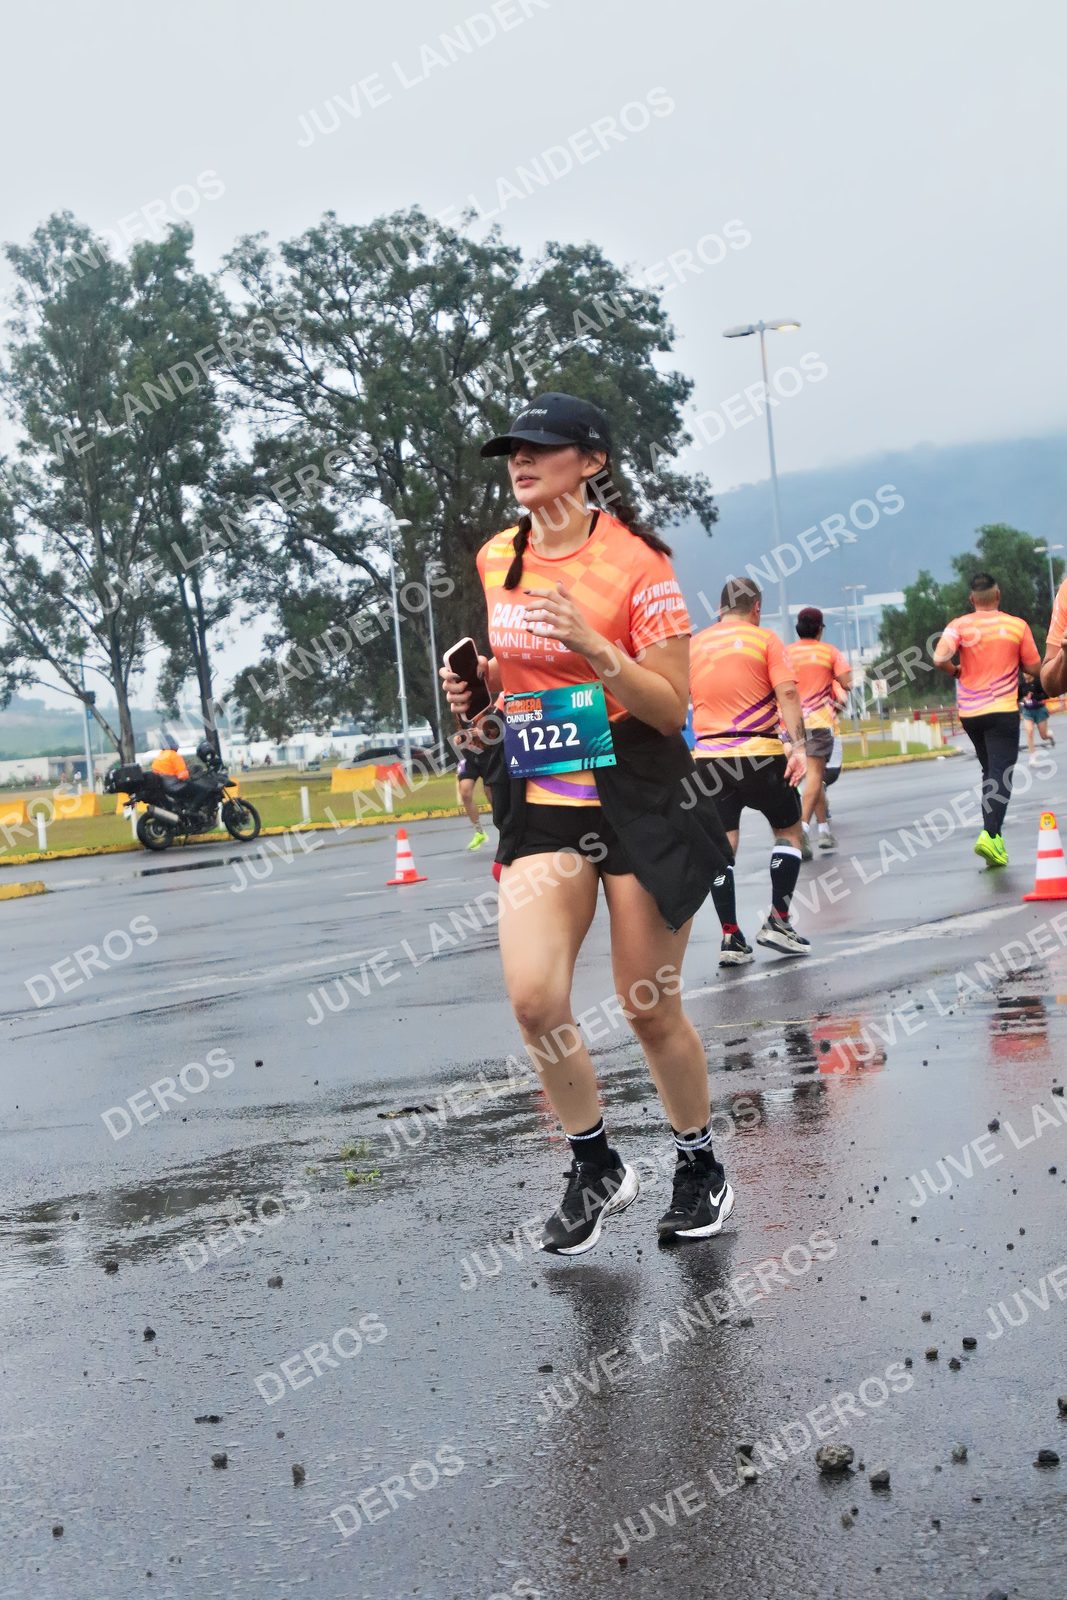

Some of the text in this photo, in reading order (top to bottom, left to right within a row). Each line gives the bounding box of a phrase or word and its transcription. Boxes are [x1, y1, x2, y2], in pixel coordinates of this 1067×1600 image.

[489, 631, 552, 651] OMNILIFE
[570, 689, 593, 709] 10K
[518, 722, 580, 752] 1222
